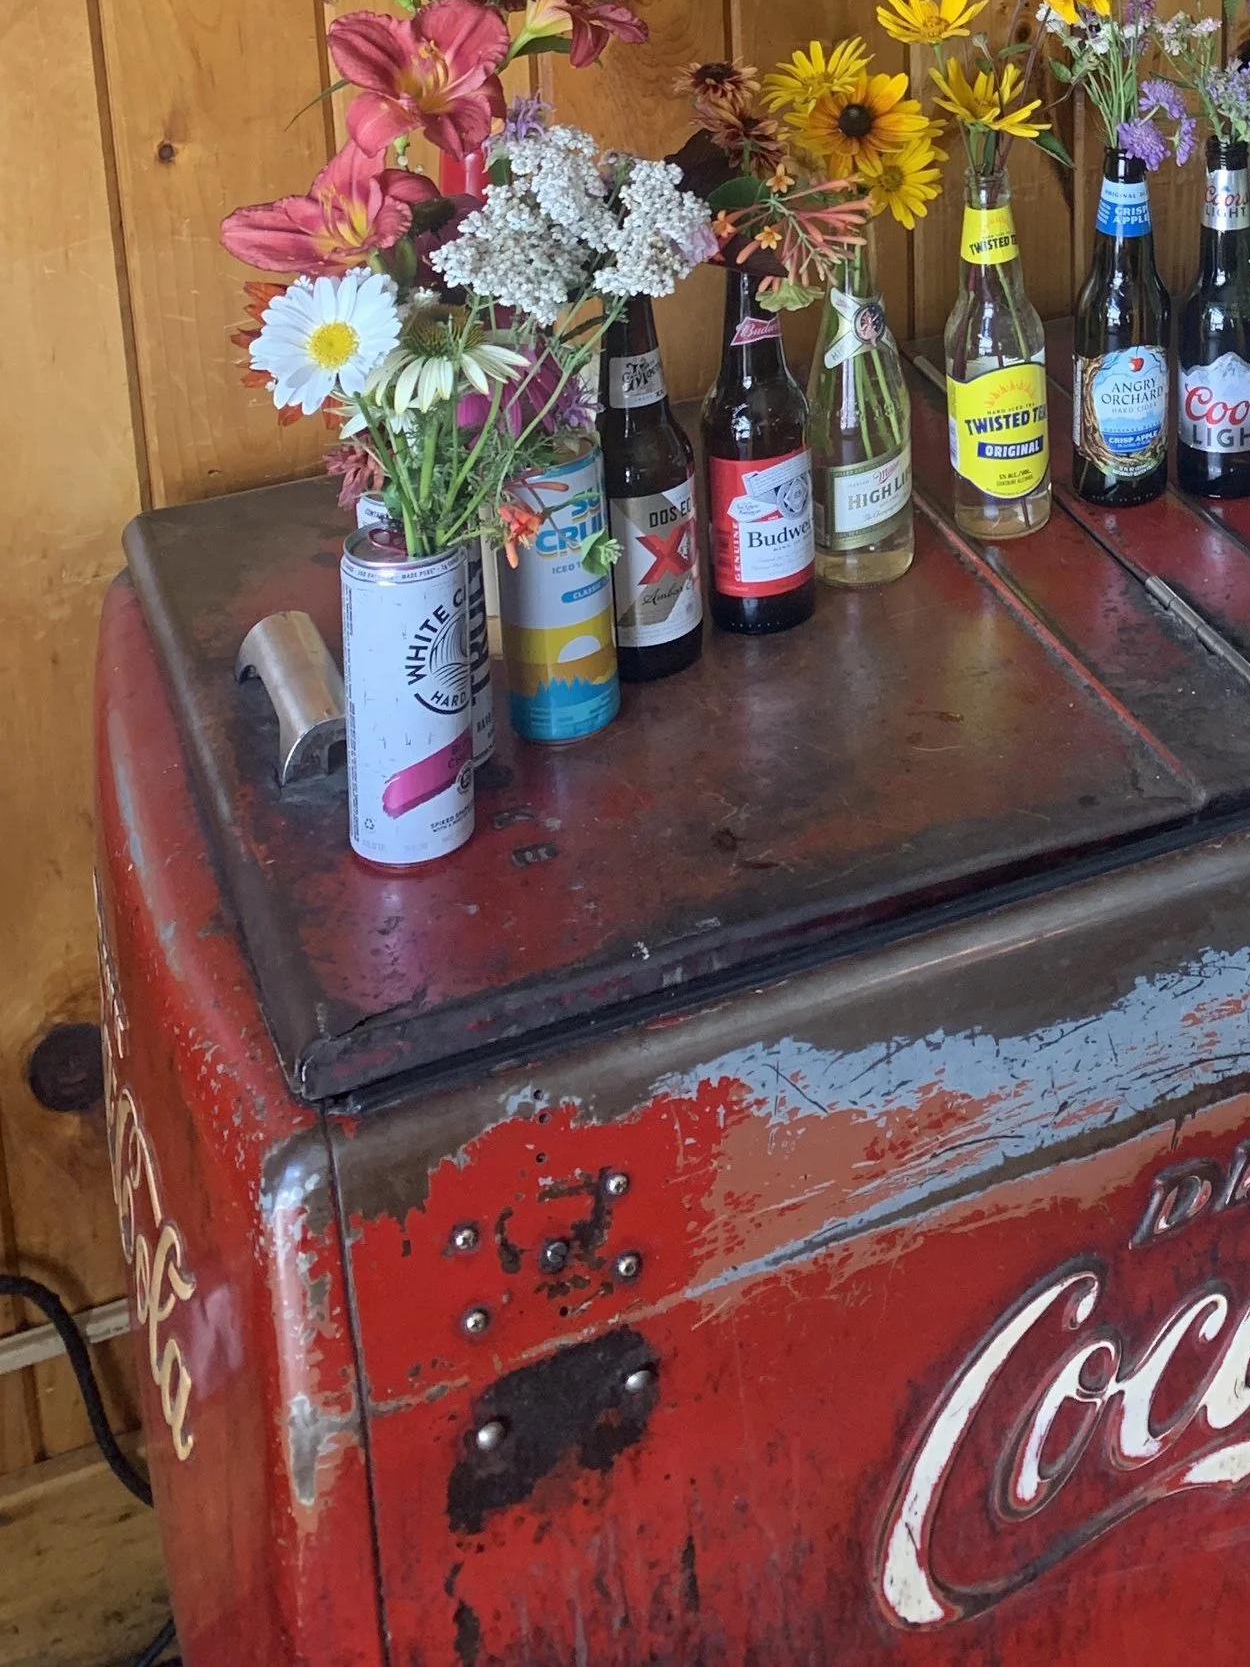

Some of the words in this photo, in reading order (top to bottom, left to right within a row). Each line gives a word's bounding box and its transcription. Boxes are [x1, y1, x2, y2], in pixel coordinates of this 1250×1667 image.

[1101, 385, 1164, 405] ORCHARD
[1112, 376, 1157, 394] ANGRY
[965, 409, 1030, 436] TWISTED
[985, 440, 1039, 457] ORIGINAL
[848, 484, 892, 510] HIGH
[649, 505, 677, 529] DOS
[732, 521, 742, 582] GENUINE
[552, 563, 575, 575] ICED
[404, 604, 451, 686] WHITE
[430, 690, 466, 708] HARD
